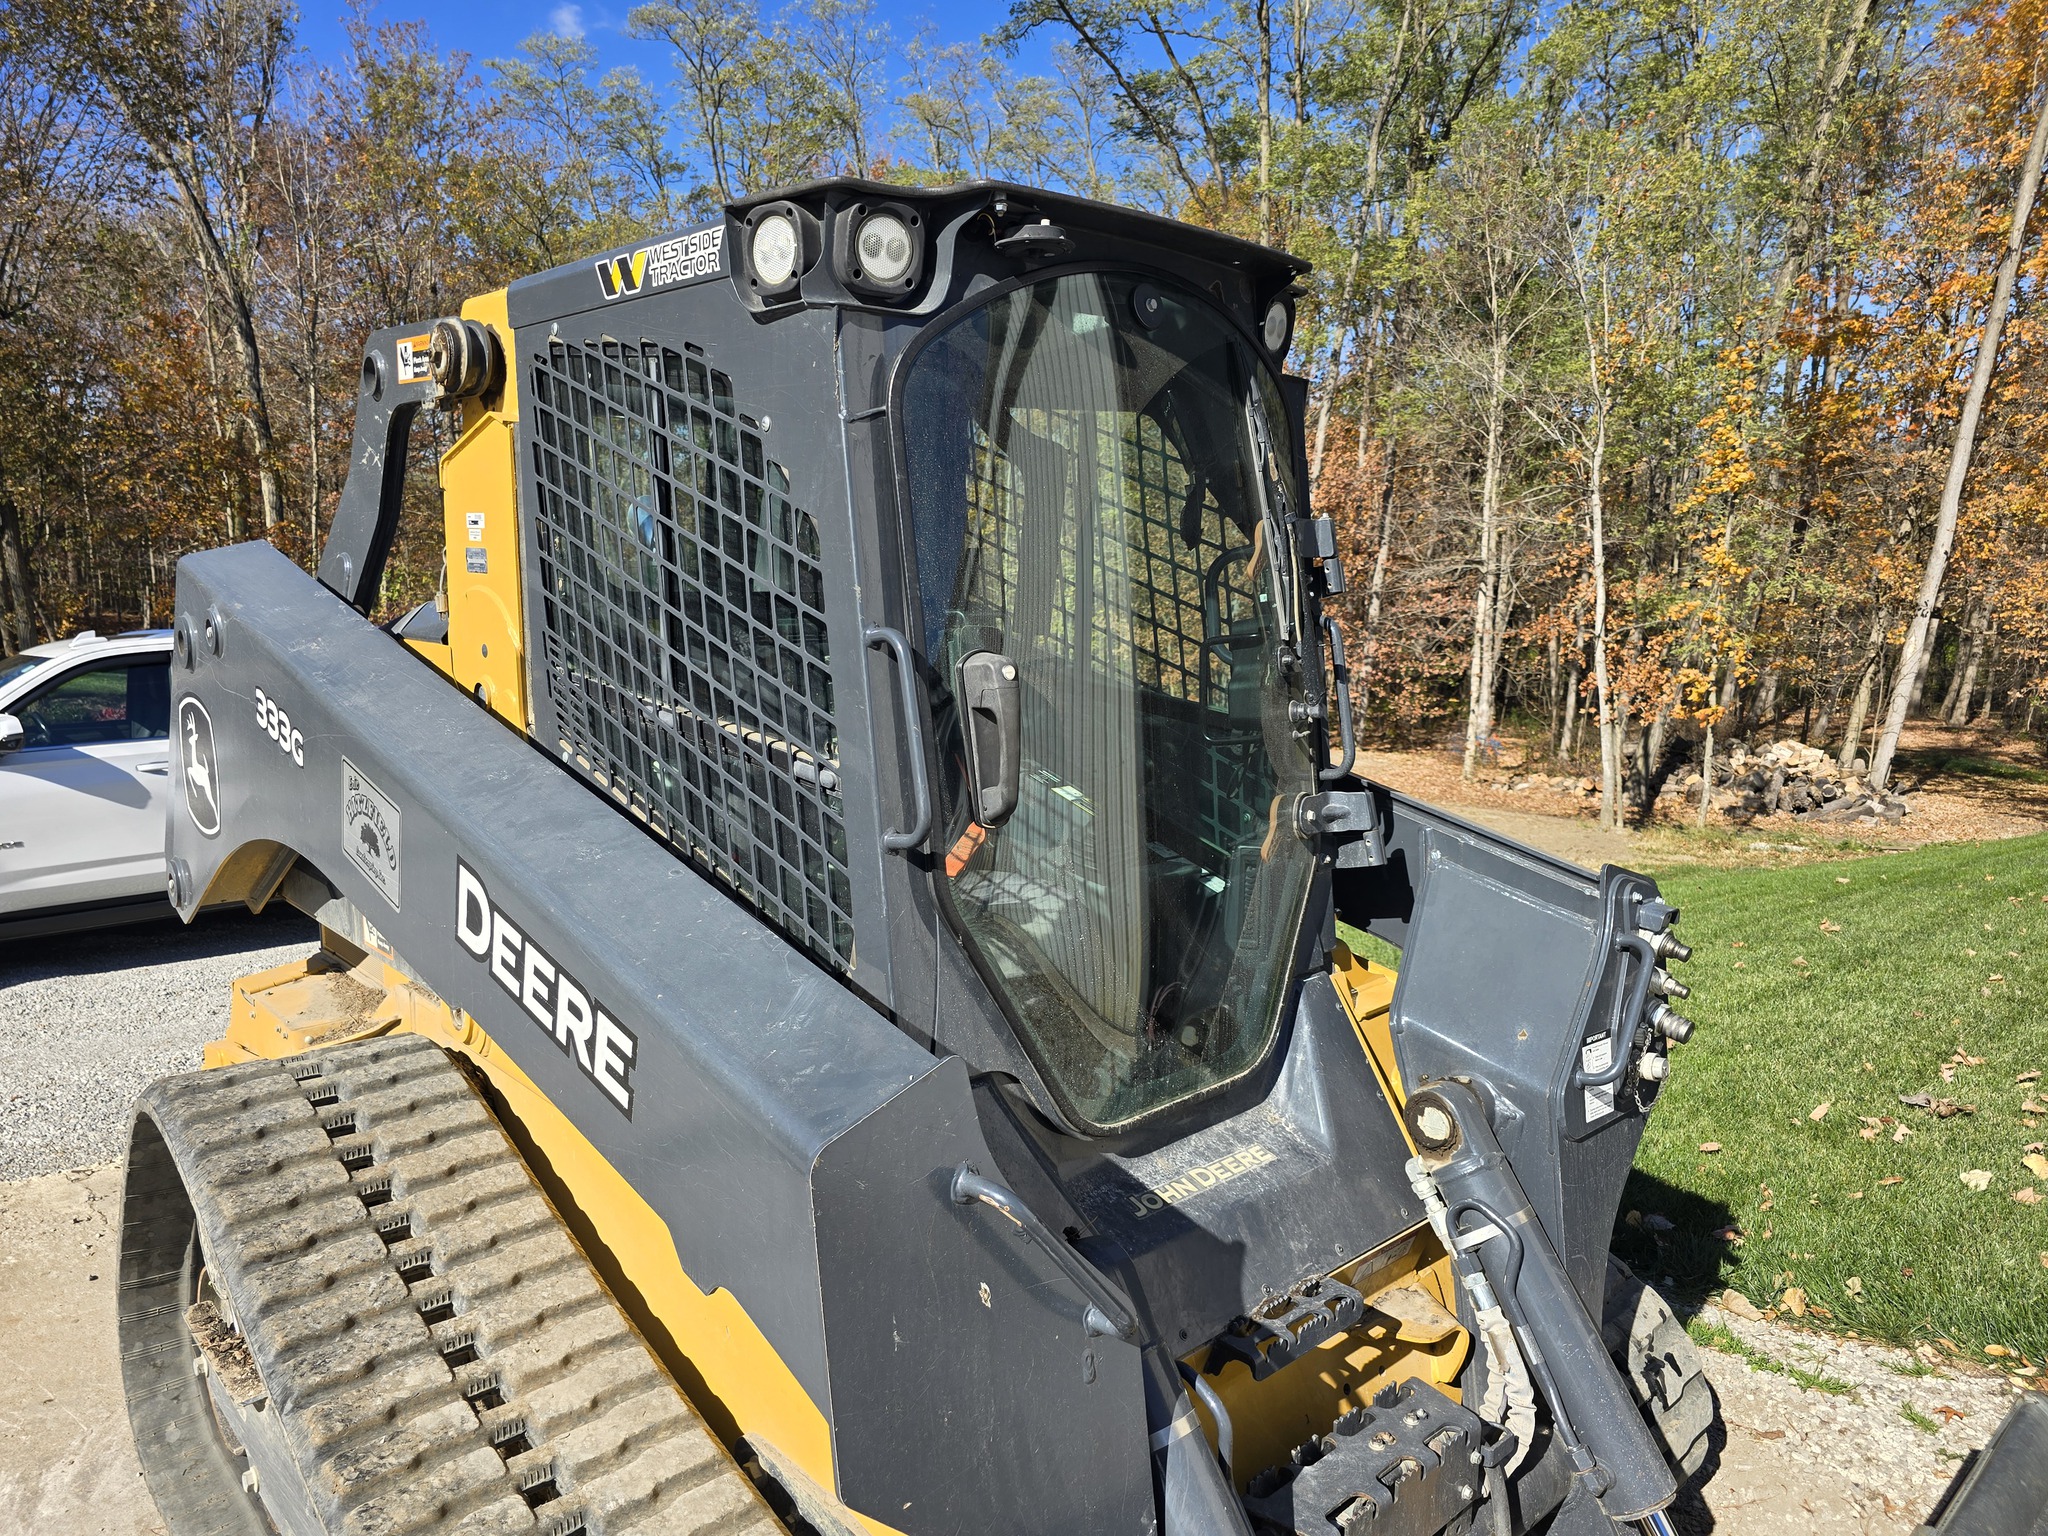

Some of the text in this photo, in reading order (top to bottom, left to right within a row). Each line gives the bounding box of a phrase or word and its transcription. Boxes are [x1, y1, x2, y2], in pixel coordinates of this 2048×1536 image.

[649, 251, 720, 287] TRACTOR
[255, 684, 305, 769] 333G
[456, 862, 635, 1111] DEERE
[1586, 1031, 1607, 1044] IMPORTANT
[1128, 1144, 1272, 1218] JOHN DEERE
